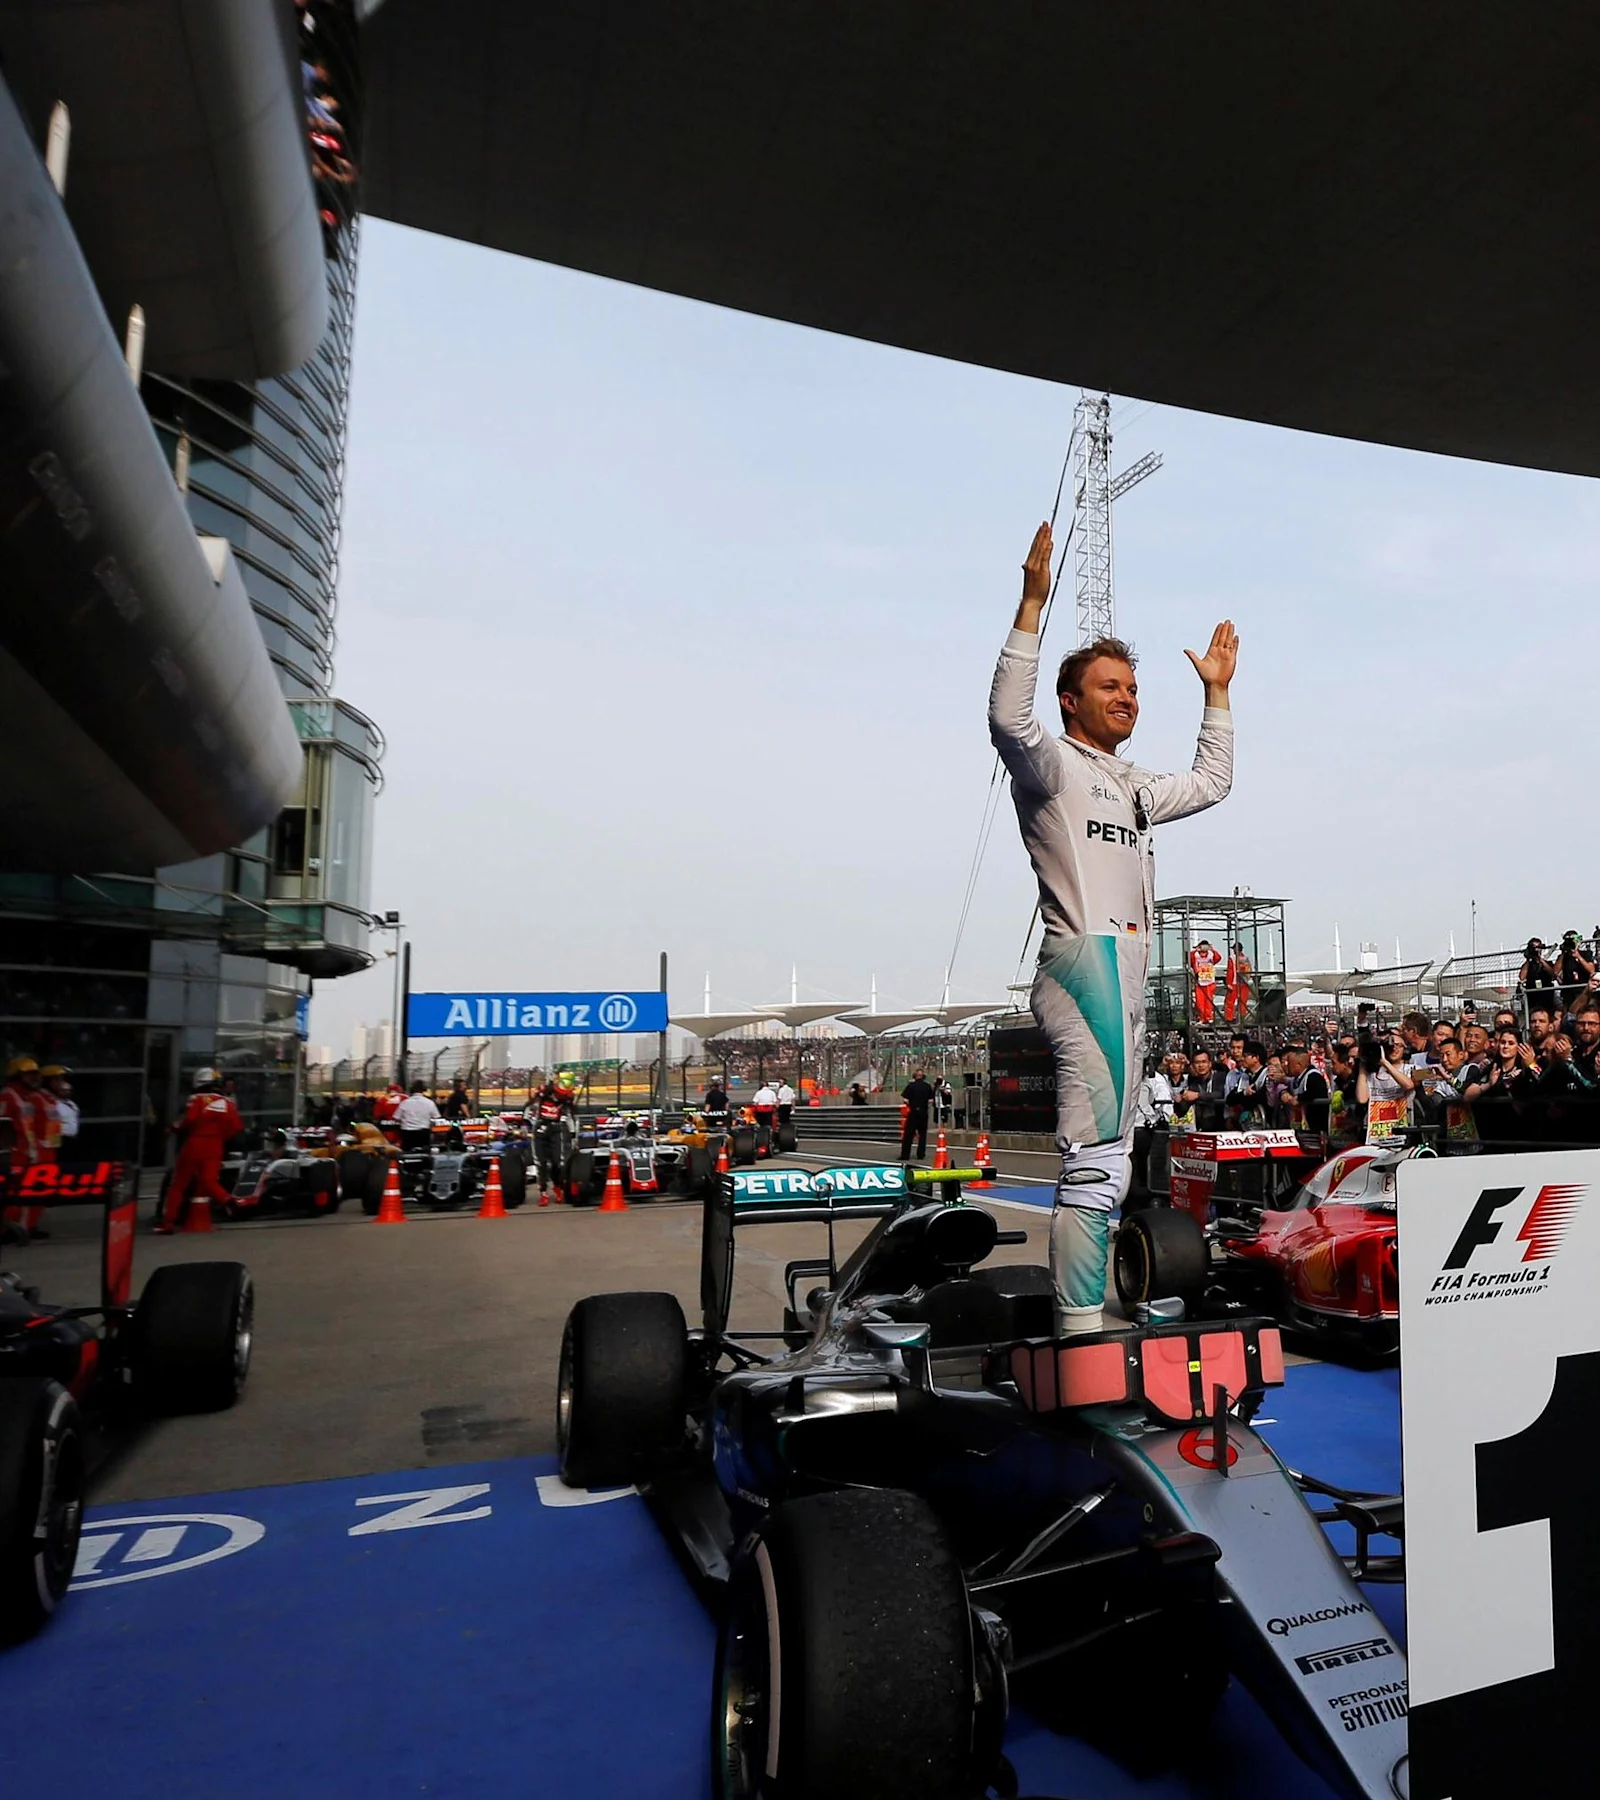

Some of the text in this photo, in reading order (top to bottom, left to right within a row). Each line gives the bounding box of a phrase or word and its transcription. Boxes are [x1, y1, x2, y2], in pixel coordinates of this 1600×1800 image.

[444, 998, 591, 1029] Allianz
[734, 1169, 903, 1195] PETRONAS
[1442, 1184, 1593, 1270] F1
[1431, 1266, 1551, 1291] FIA Formula 1
[1424, 1295, 1461, 1306] WORLD
[1177, 1428, 1239, 1470] 6
[1294, 1638, 1394, 1676] PIRELLI
[1328, 1679, 1408, 1709] PETRONAS
[1340, 1695, 1410, 1732] SYNTIU
